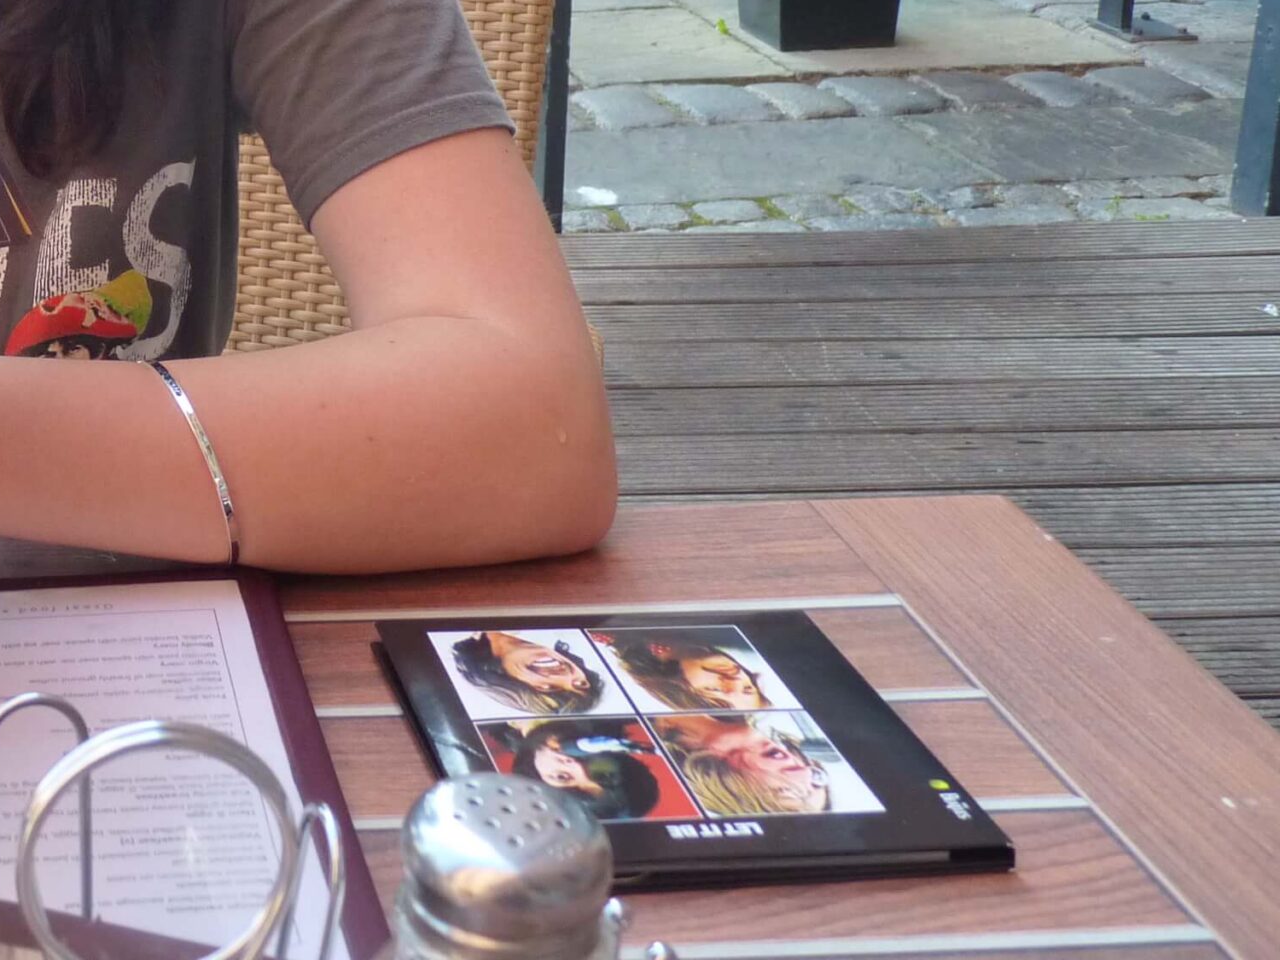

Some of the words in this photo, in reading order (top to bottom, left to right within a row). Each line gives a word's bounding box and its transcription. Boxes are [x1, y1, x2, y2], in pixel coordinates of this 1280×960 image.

[665, 824, 699, 839] BE
[699, 823, 723, 838] IT
[723, 821, 764, 837] LET
